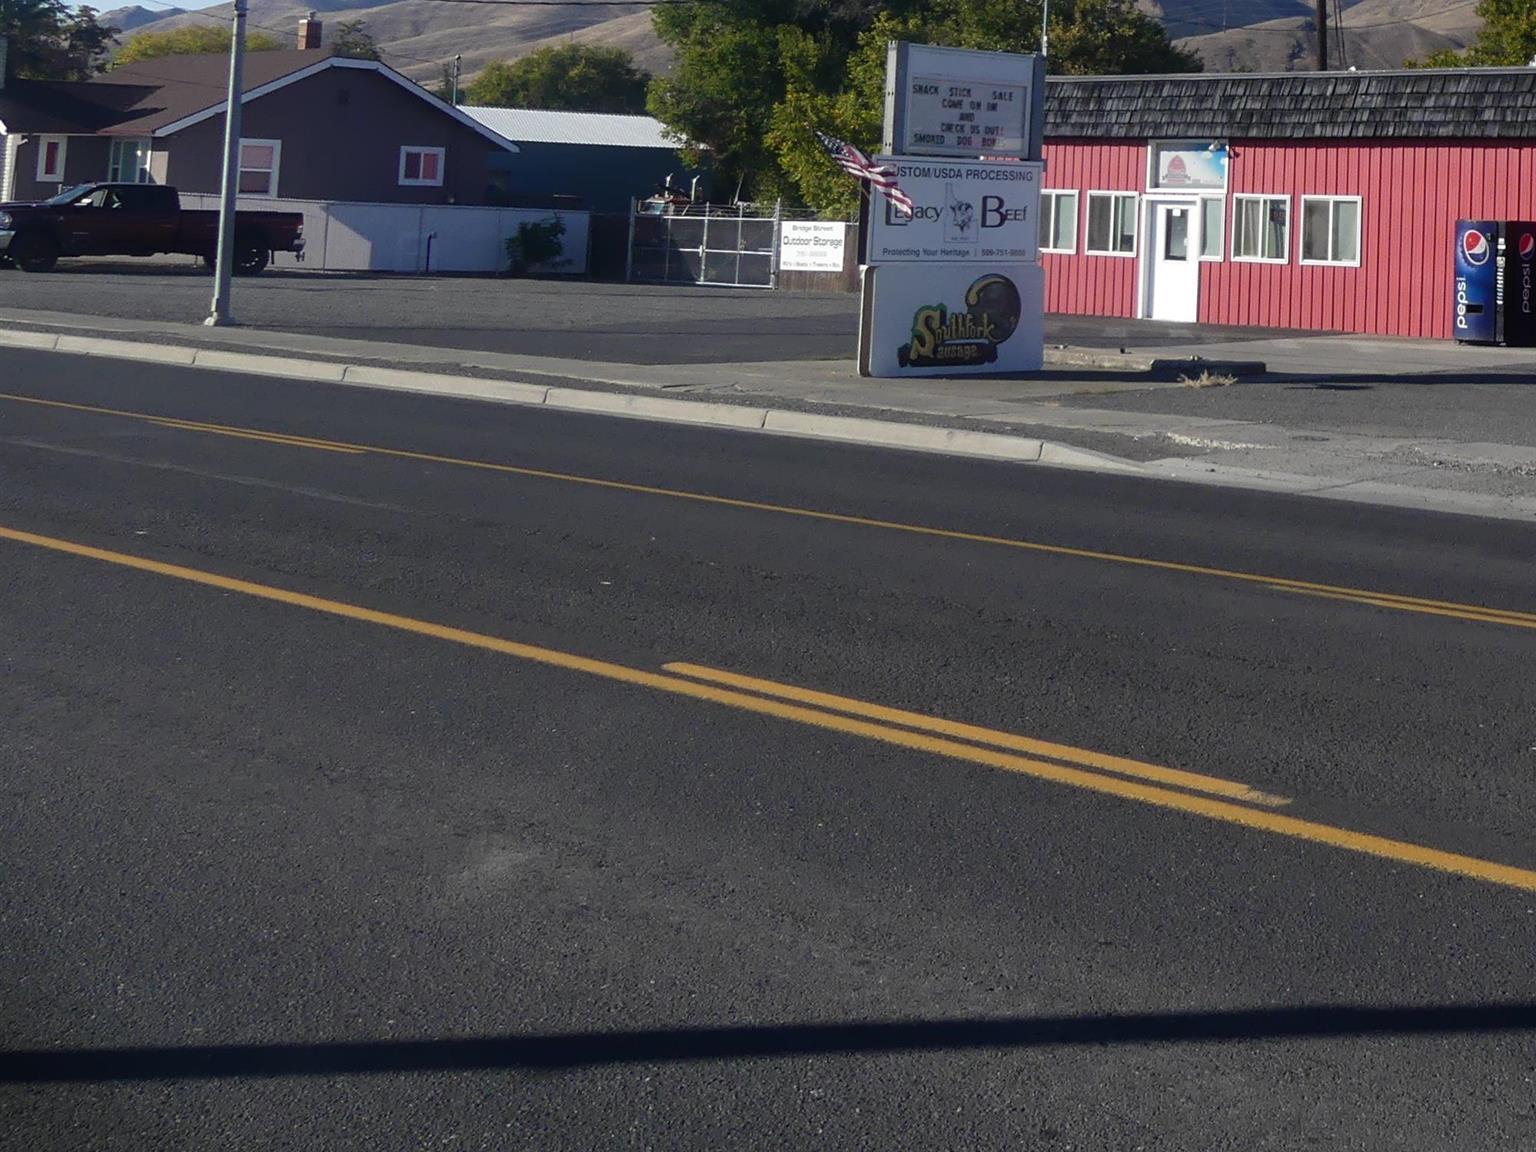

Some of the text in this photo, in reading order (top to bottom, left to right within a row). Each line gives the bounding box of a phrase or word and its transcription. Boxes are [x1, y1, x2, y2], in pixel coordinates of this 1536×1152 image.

[913, 84, 1013, 102] SNACK STICK SALE
[942, 98, 963, 110] COME
[959, 112, 975, 122] AND
[941, 122, 965, 133] CHECK
[913, 133, 945, 145] SMOKED
[957, 135, 972, 146] DOG
[966, 168, 1033, 181] PROCESSING
[783, 235, 843, 249] Outdoor Storage
[883, 248, 920, 258] Protecting
[923, 248, 938, 256] Your
[940, 249, 970, 258] Heritage
[1522, 264, 1531, 313] pepsi
[1456, 276, 1469, 329] pepsi
